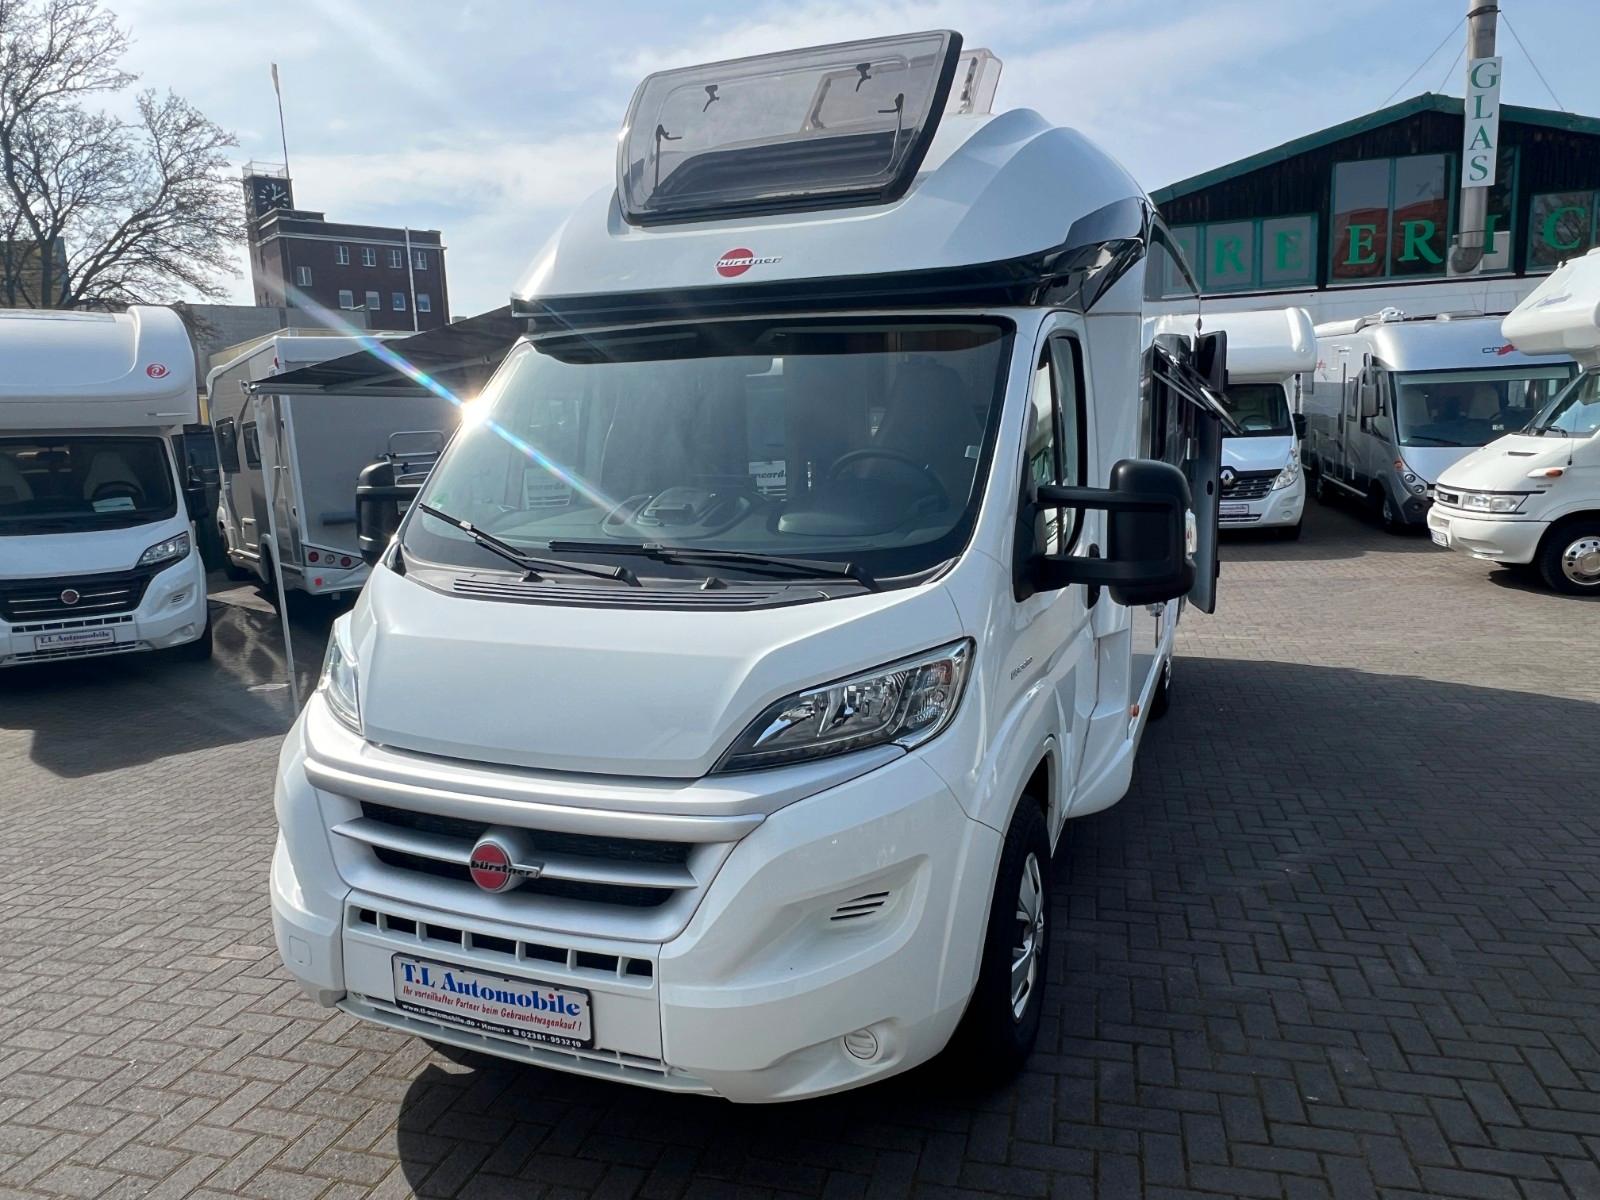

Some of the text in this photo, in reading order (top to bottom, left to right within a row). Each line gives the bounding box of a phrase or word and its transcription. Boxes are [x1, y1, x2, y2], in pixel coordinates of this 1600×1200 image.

[1468, 61, 1500, 181] GLAS
[400, 962, 581, 1017] T.L Automobile
[402, 985, 413, 996] Ihr
[414, 988, 454, 1006] vorteilhafter
[455, 997, 480, 1011] Partner
[482, 1003, 499, 1016] beim
[500, 1007, 577, 1030] Gebrauchtwagenkauf
